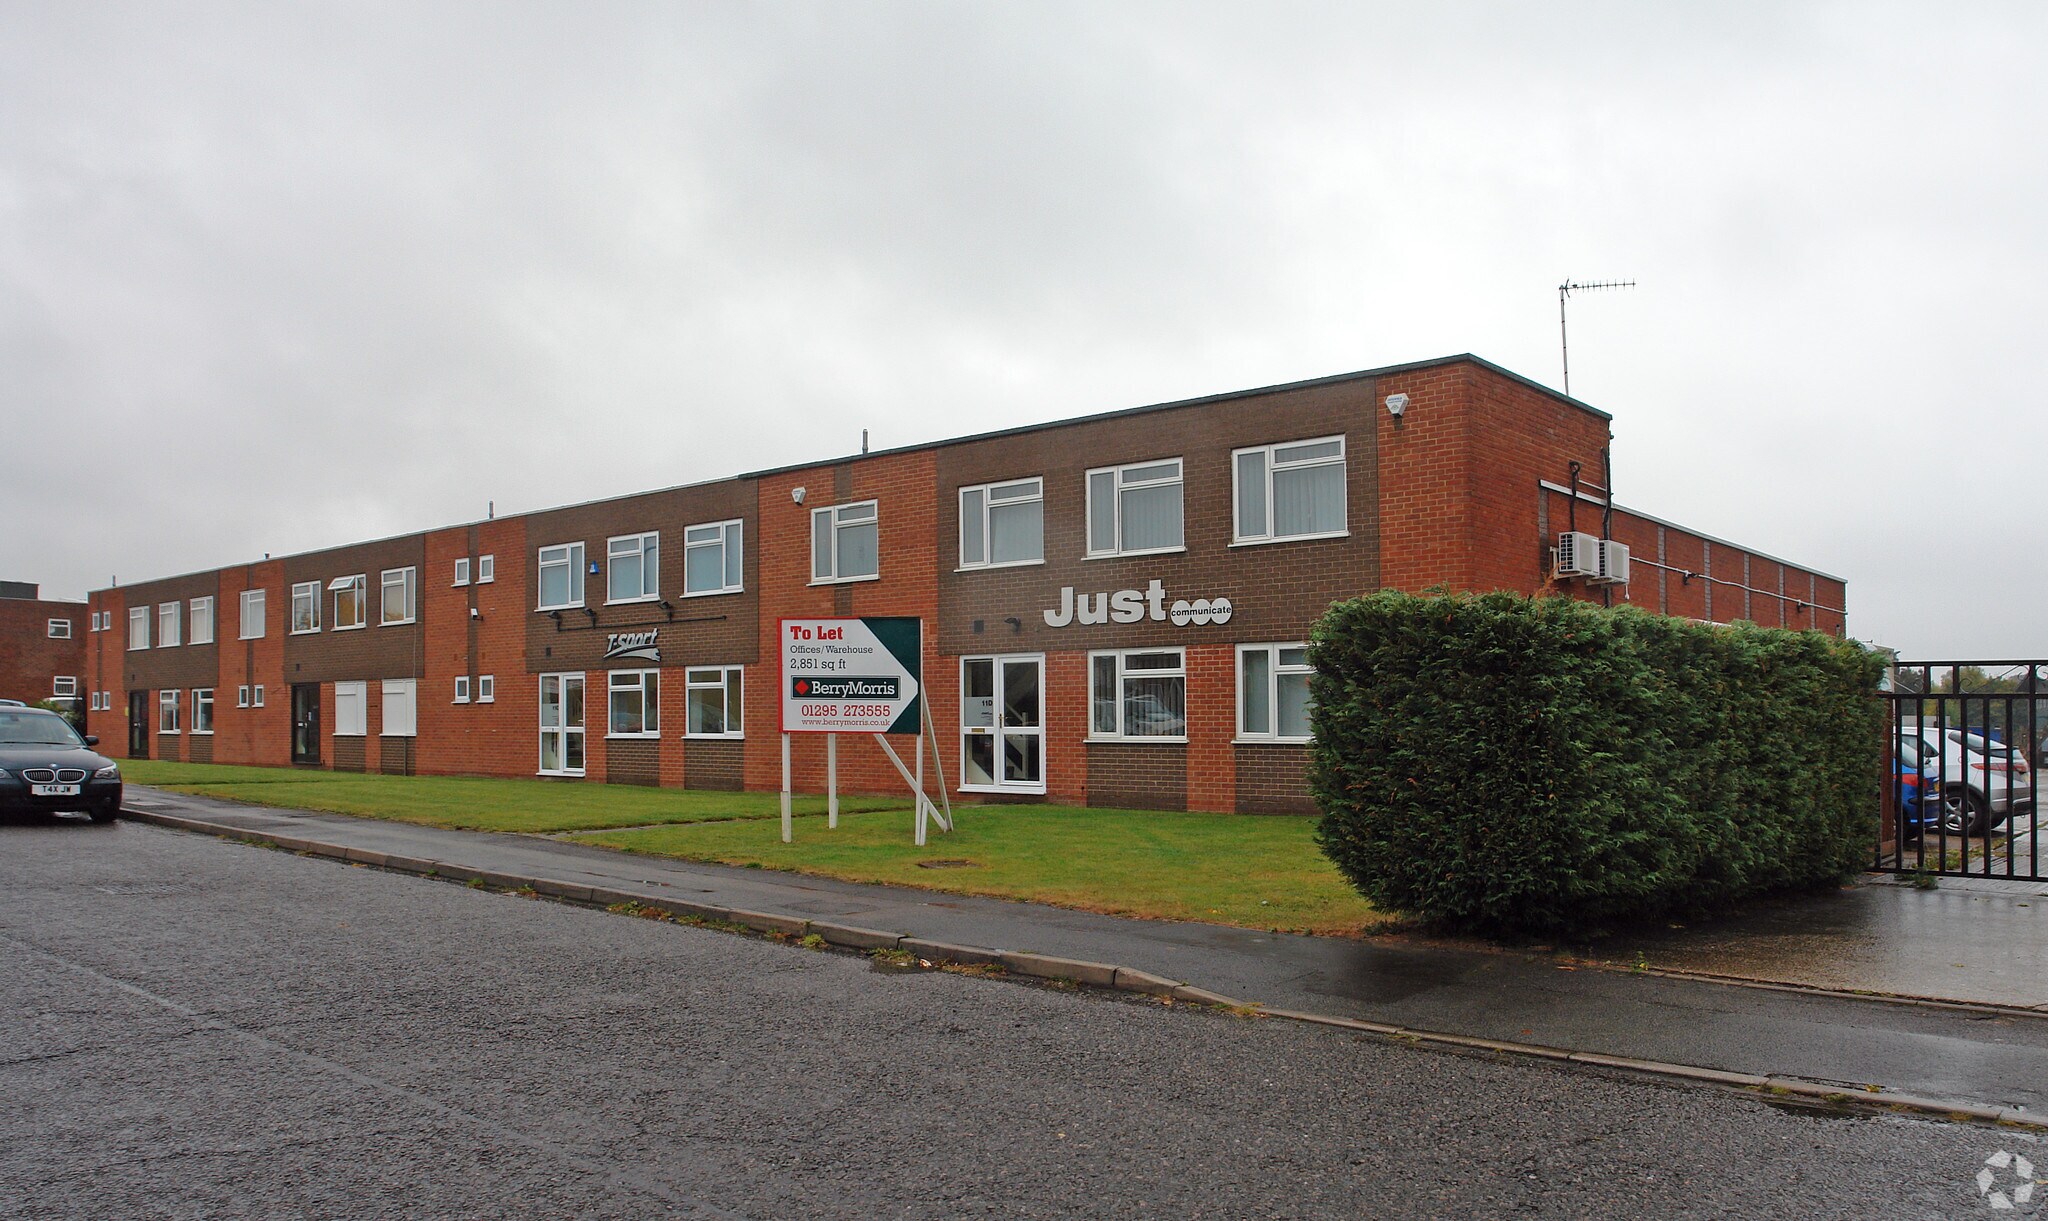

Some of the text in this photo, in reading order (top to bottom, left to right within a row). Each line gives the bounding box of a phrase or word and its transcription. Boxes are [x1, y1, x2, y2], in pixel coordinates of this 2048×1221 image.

[1044, 579, 1167, 627] Just
[1171, 606, 1232, 617] communicate
[790, 626, 843, 640] To Let
[790, 659, 846, 671] 2,851 sq ft
[811, 681, 895, 698] BerryMorris
[801, 705, 891, 717] 01295 273555
[801, 718, 890, 727] www.berrymorris.co.uk
